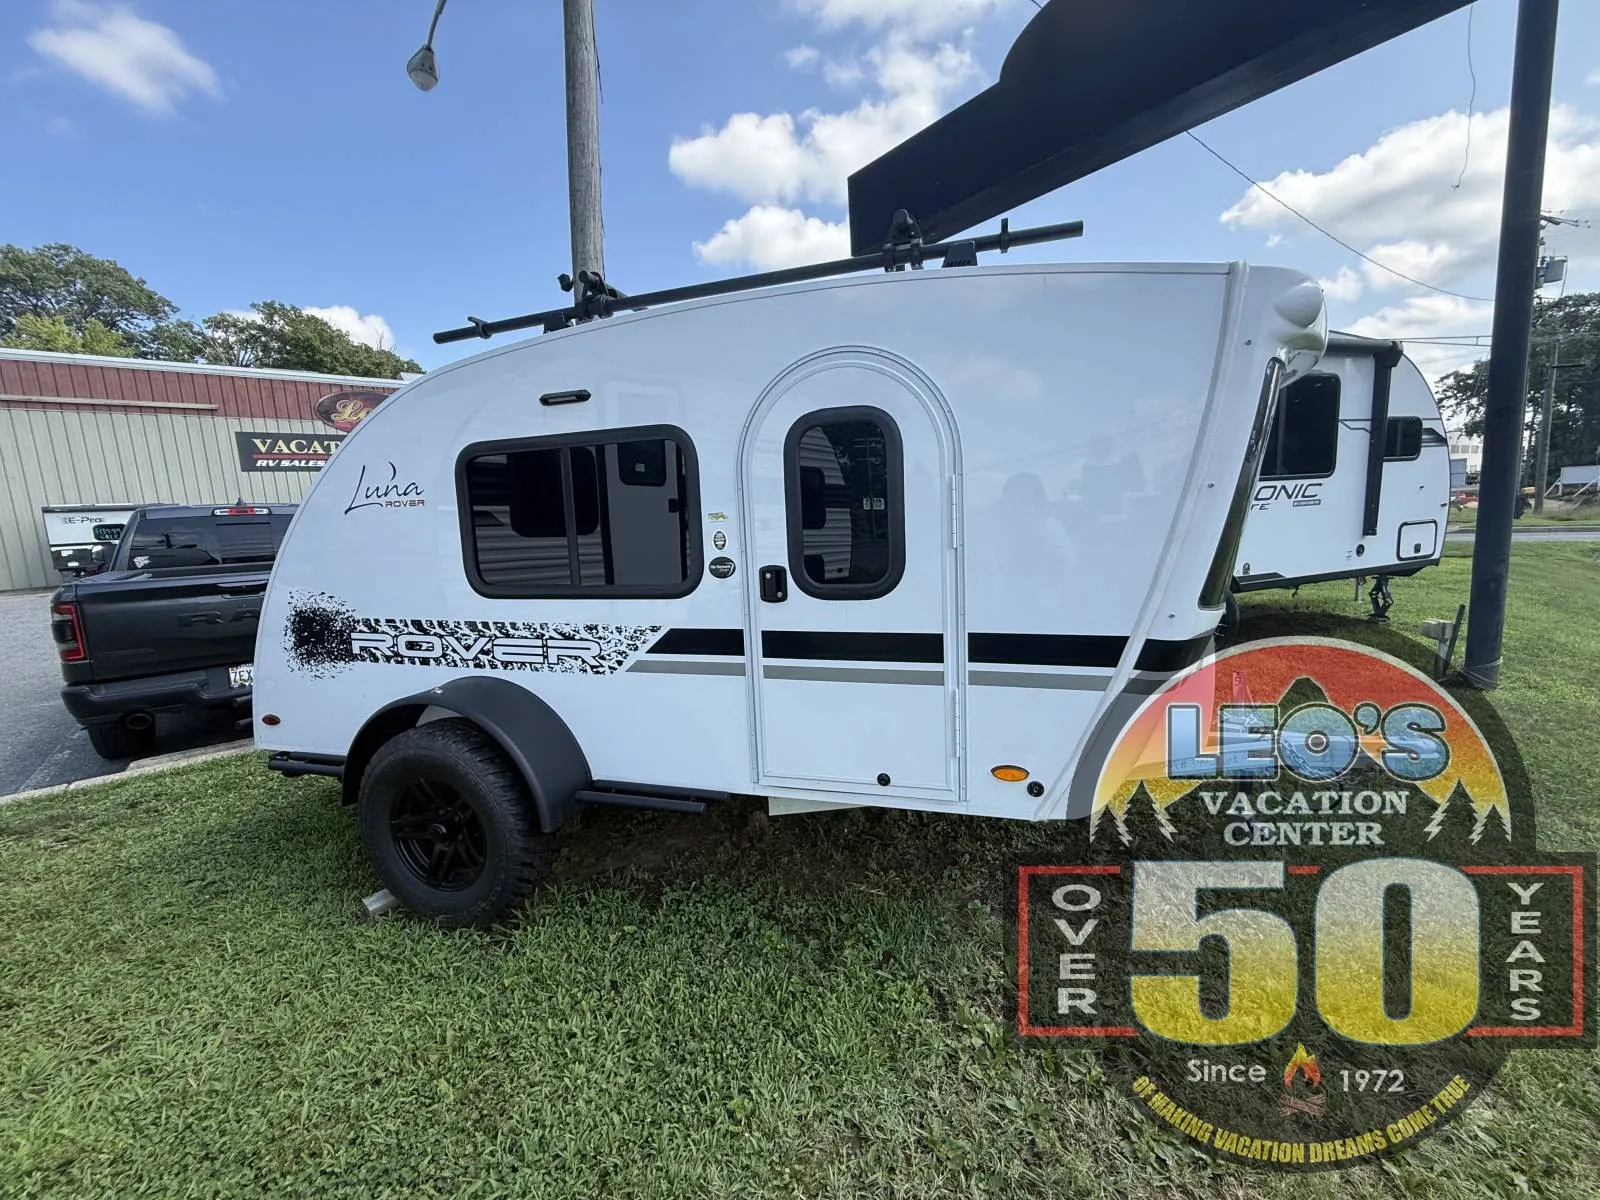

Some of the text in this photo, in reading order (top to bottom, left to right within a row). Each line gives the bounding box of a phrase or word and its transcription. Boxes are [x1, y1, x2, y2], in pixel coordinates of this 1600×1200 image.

[256, 459, 279, 467] RV
[344, 461, 425, 515] Luna
[350, 632, 604, 675] ROVER
